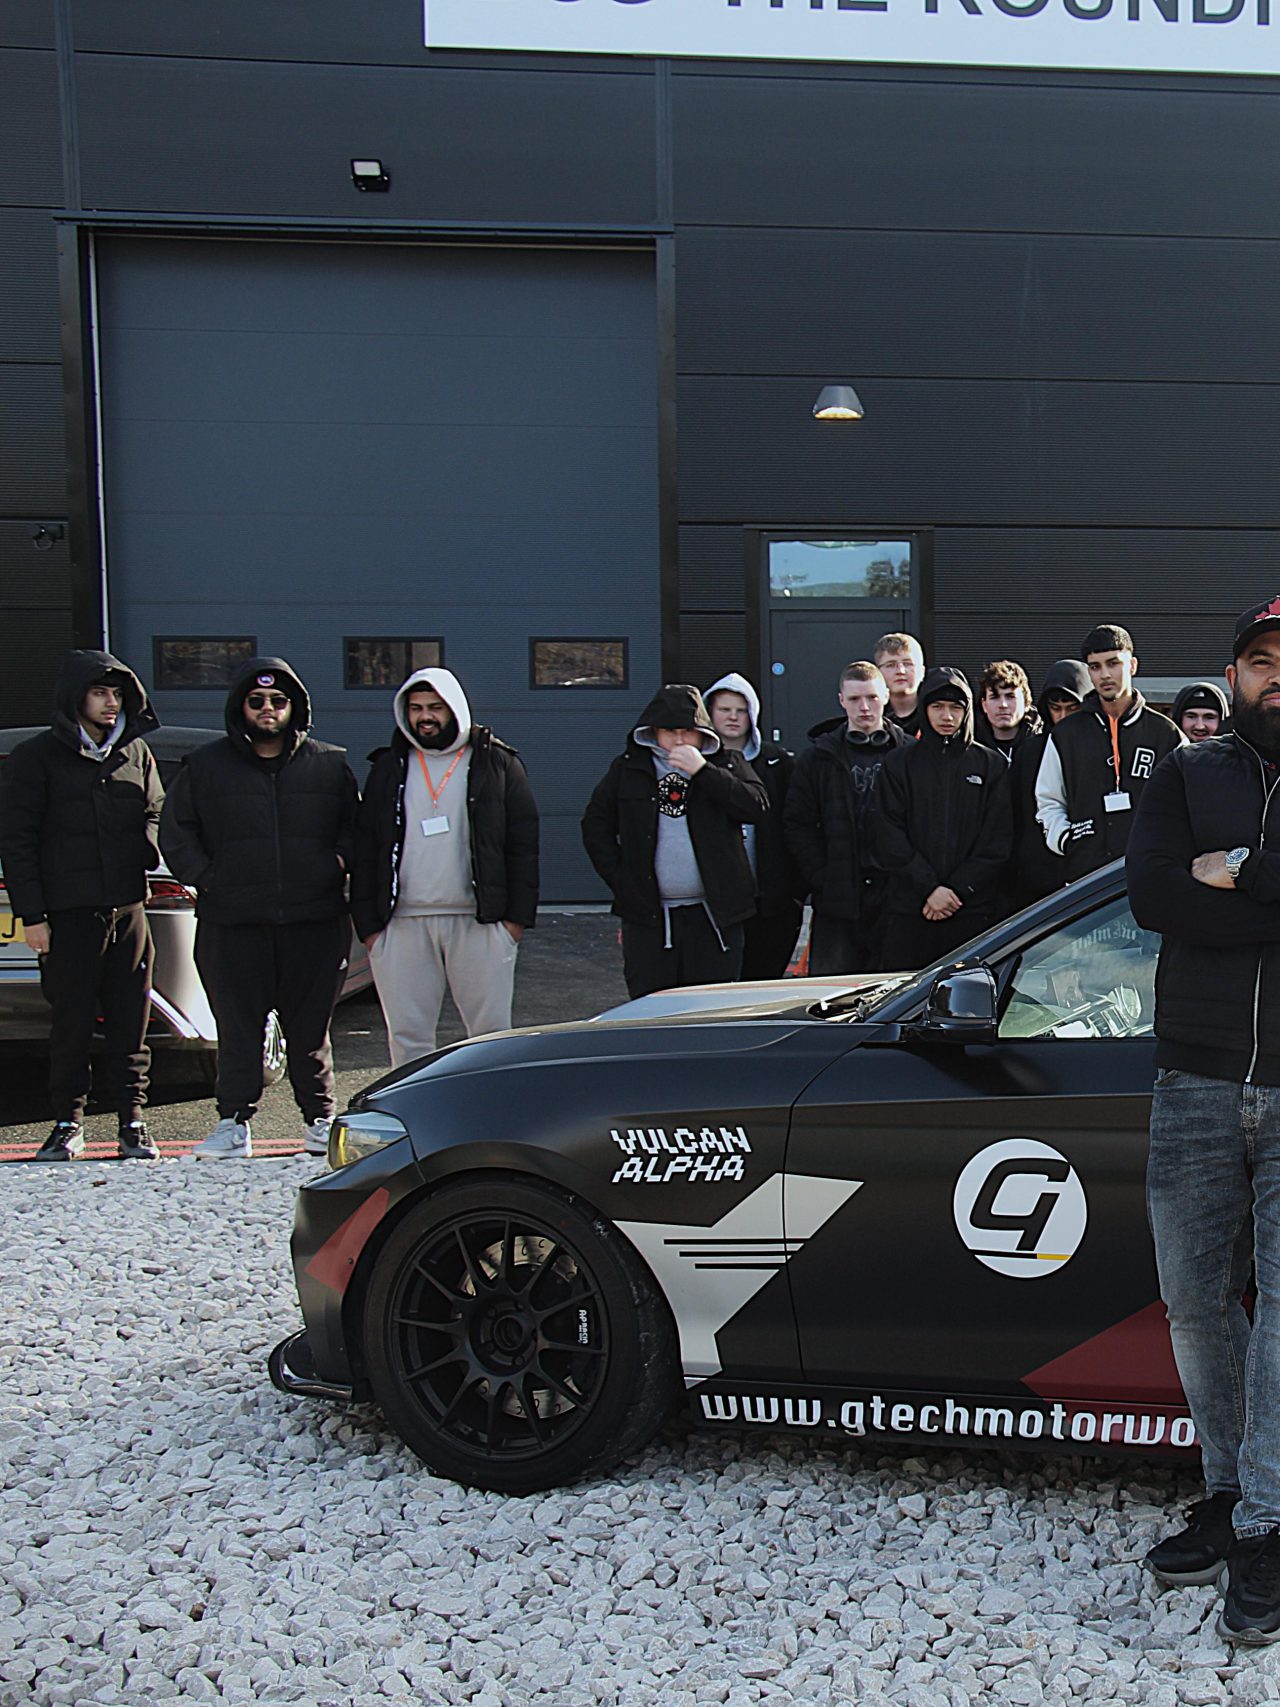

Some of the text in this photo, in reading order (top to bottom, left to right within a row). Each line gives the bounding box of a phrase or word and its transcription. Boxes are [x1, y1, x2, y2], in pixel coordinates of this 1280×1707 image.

[1131, 747, 1156, 779] R
[610, 1126, 752, 1155] VULCAN
[611, 1154, 745, 1183] ALPHA
